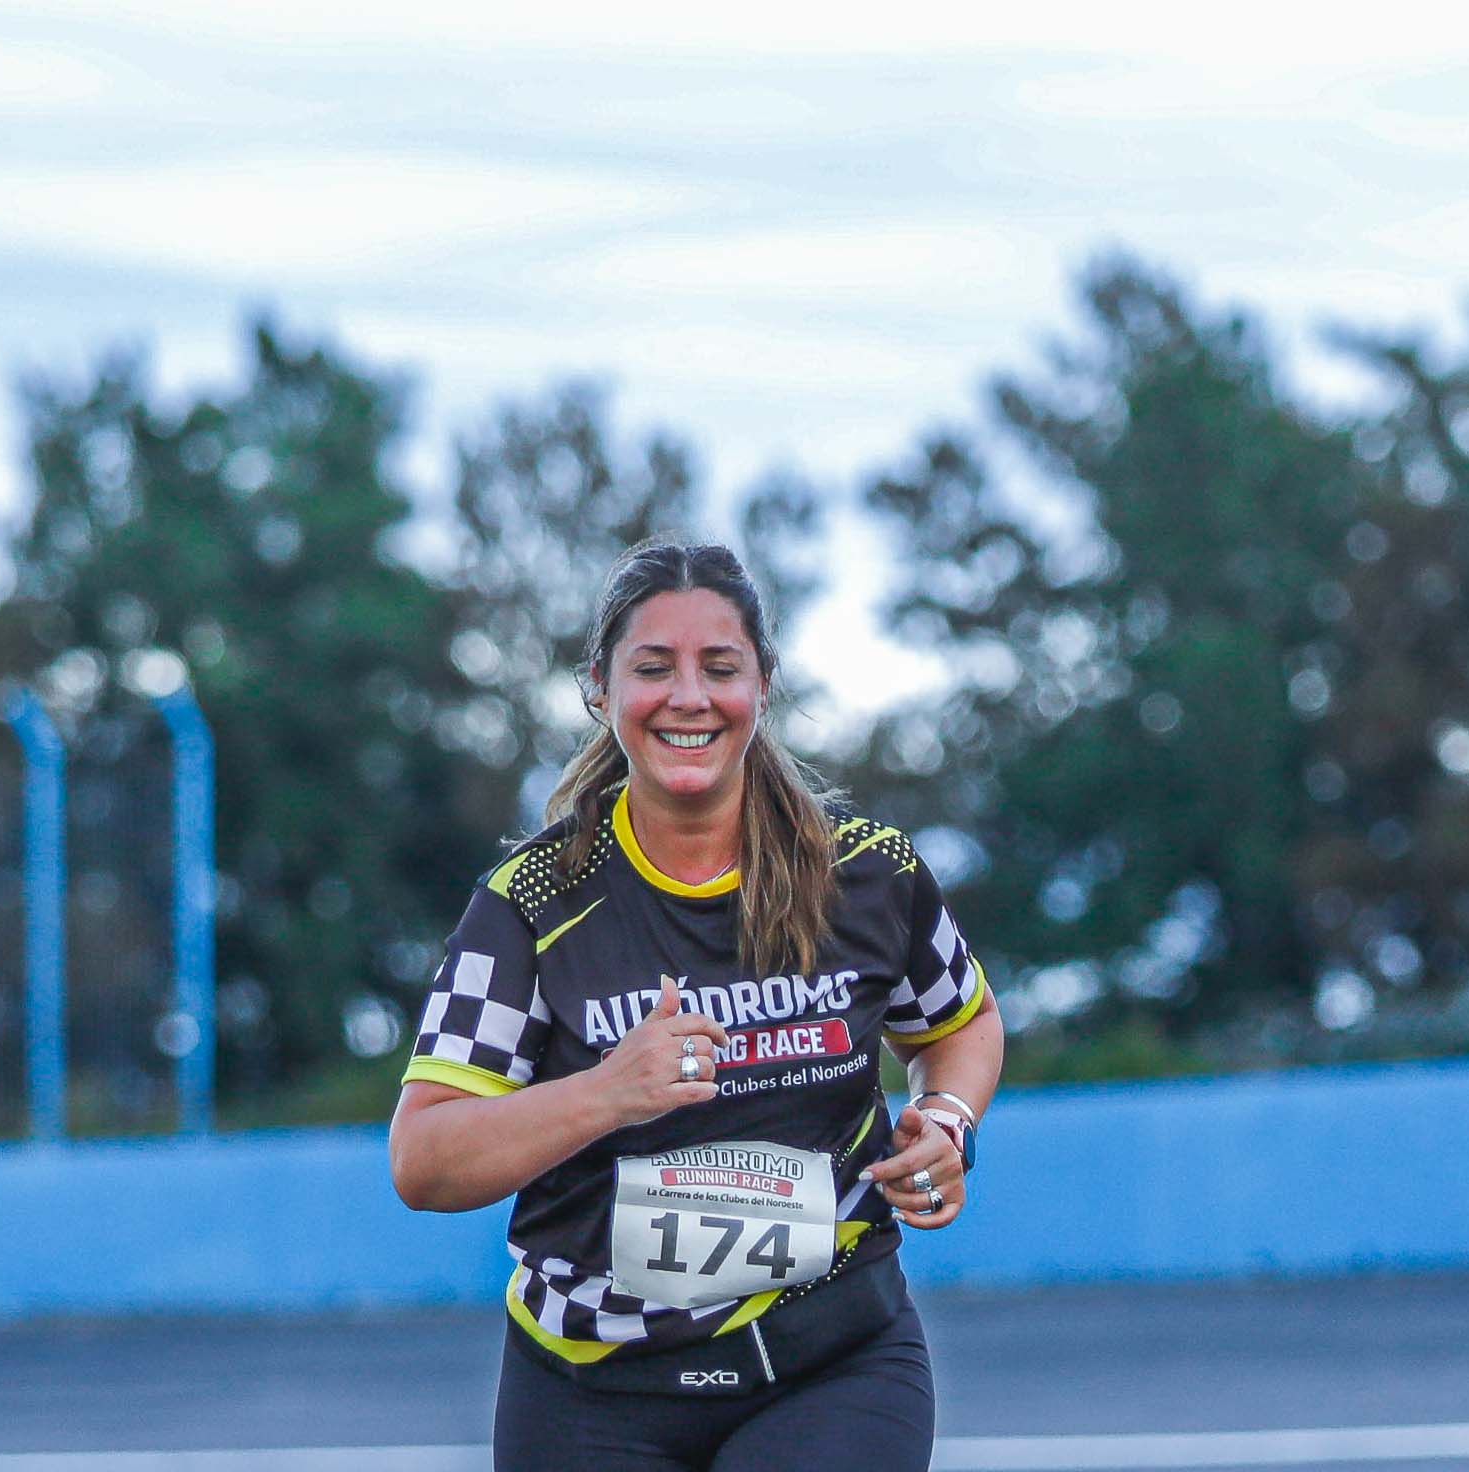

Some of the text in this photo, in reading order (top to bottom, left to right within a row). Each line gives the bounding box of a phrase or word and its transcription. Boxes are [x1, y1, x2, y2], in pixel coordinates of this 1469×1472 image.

[756, 1027, 825, 1059] RACE
[721, 1053, 868, 1096] Clubes del Noroeste
[675, 1170, 779, 1193] RUNNING RACE
[647, 1187, 804, 1210] La Carrera de los Clubes del Noroeste
[646, 1212, 796, 1279] 174
